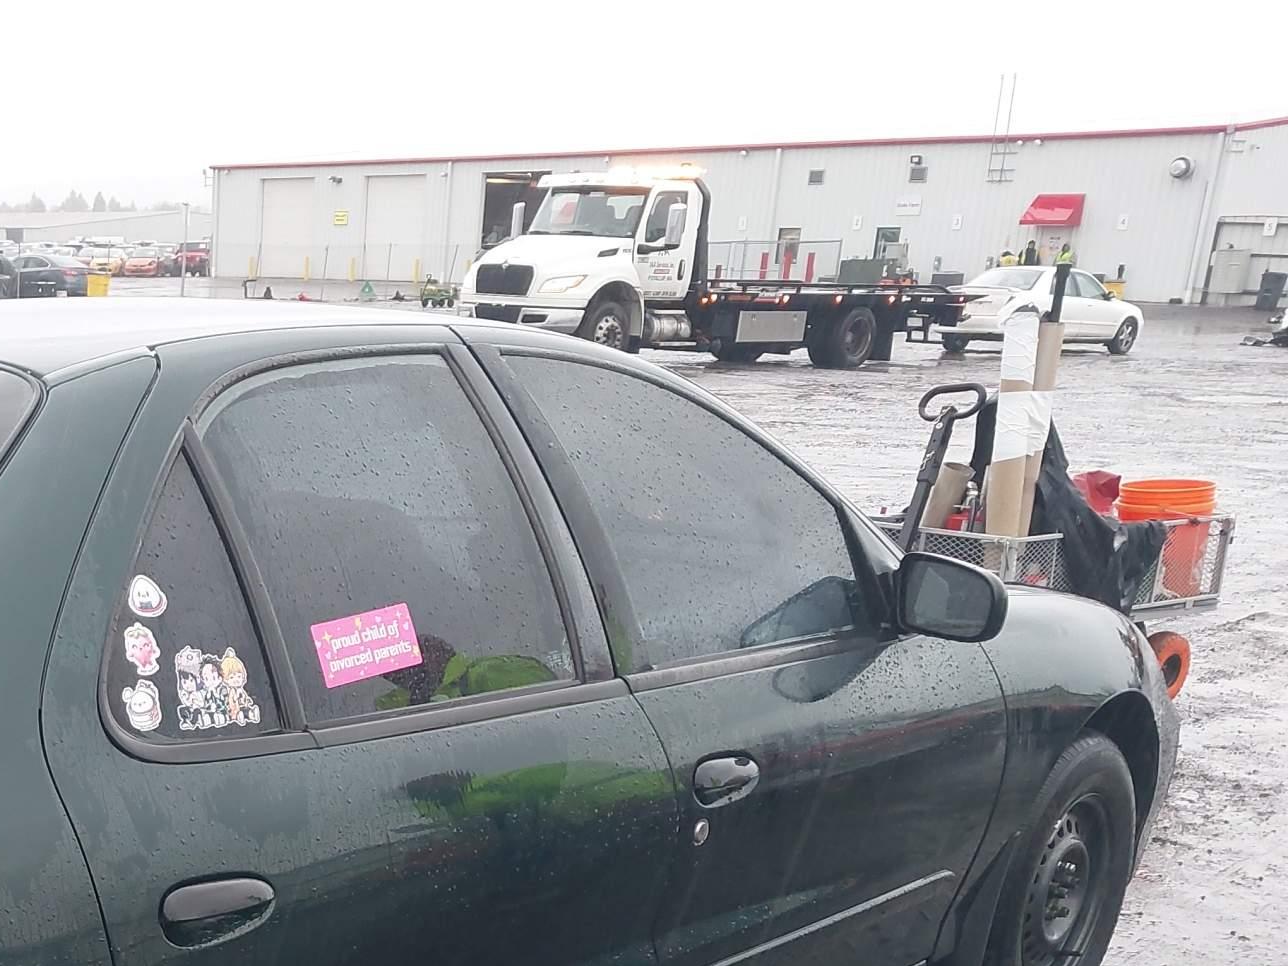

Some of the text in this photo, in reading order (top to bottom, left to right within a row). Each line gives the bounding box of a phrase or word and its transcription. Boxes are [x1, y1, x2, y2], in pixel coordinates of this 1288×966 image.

[330, 620, 399, 653] proud child of
[374, 640, 412, 664] parents
